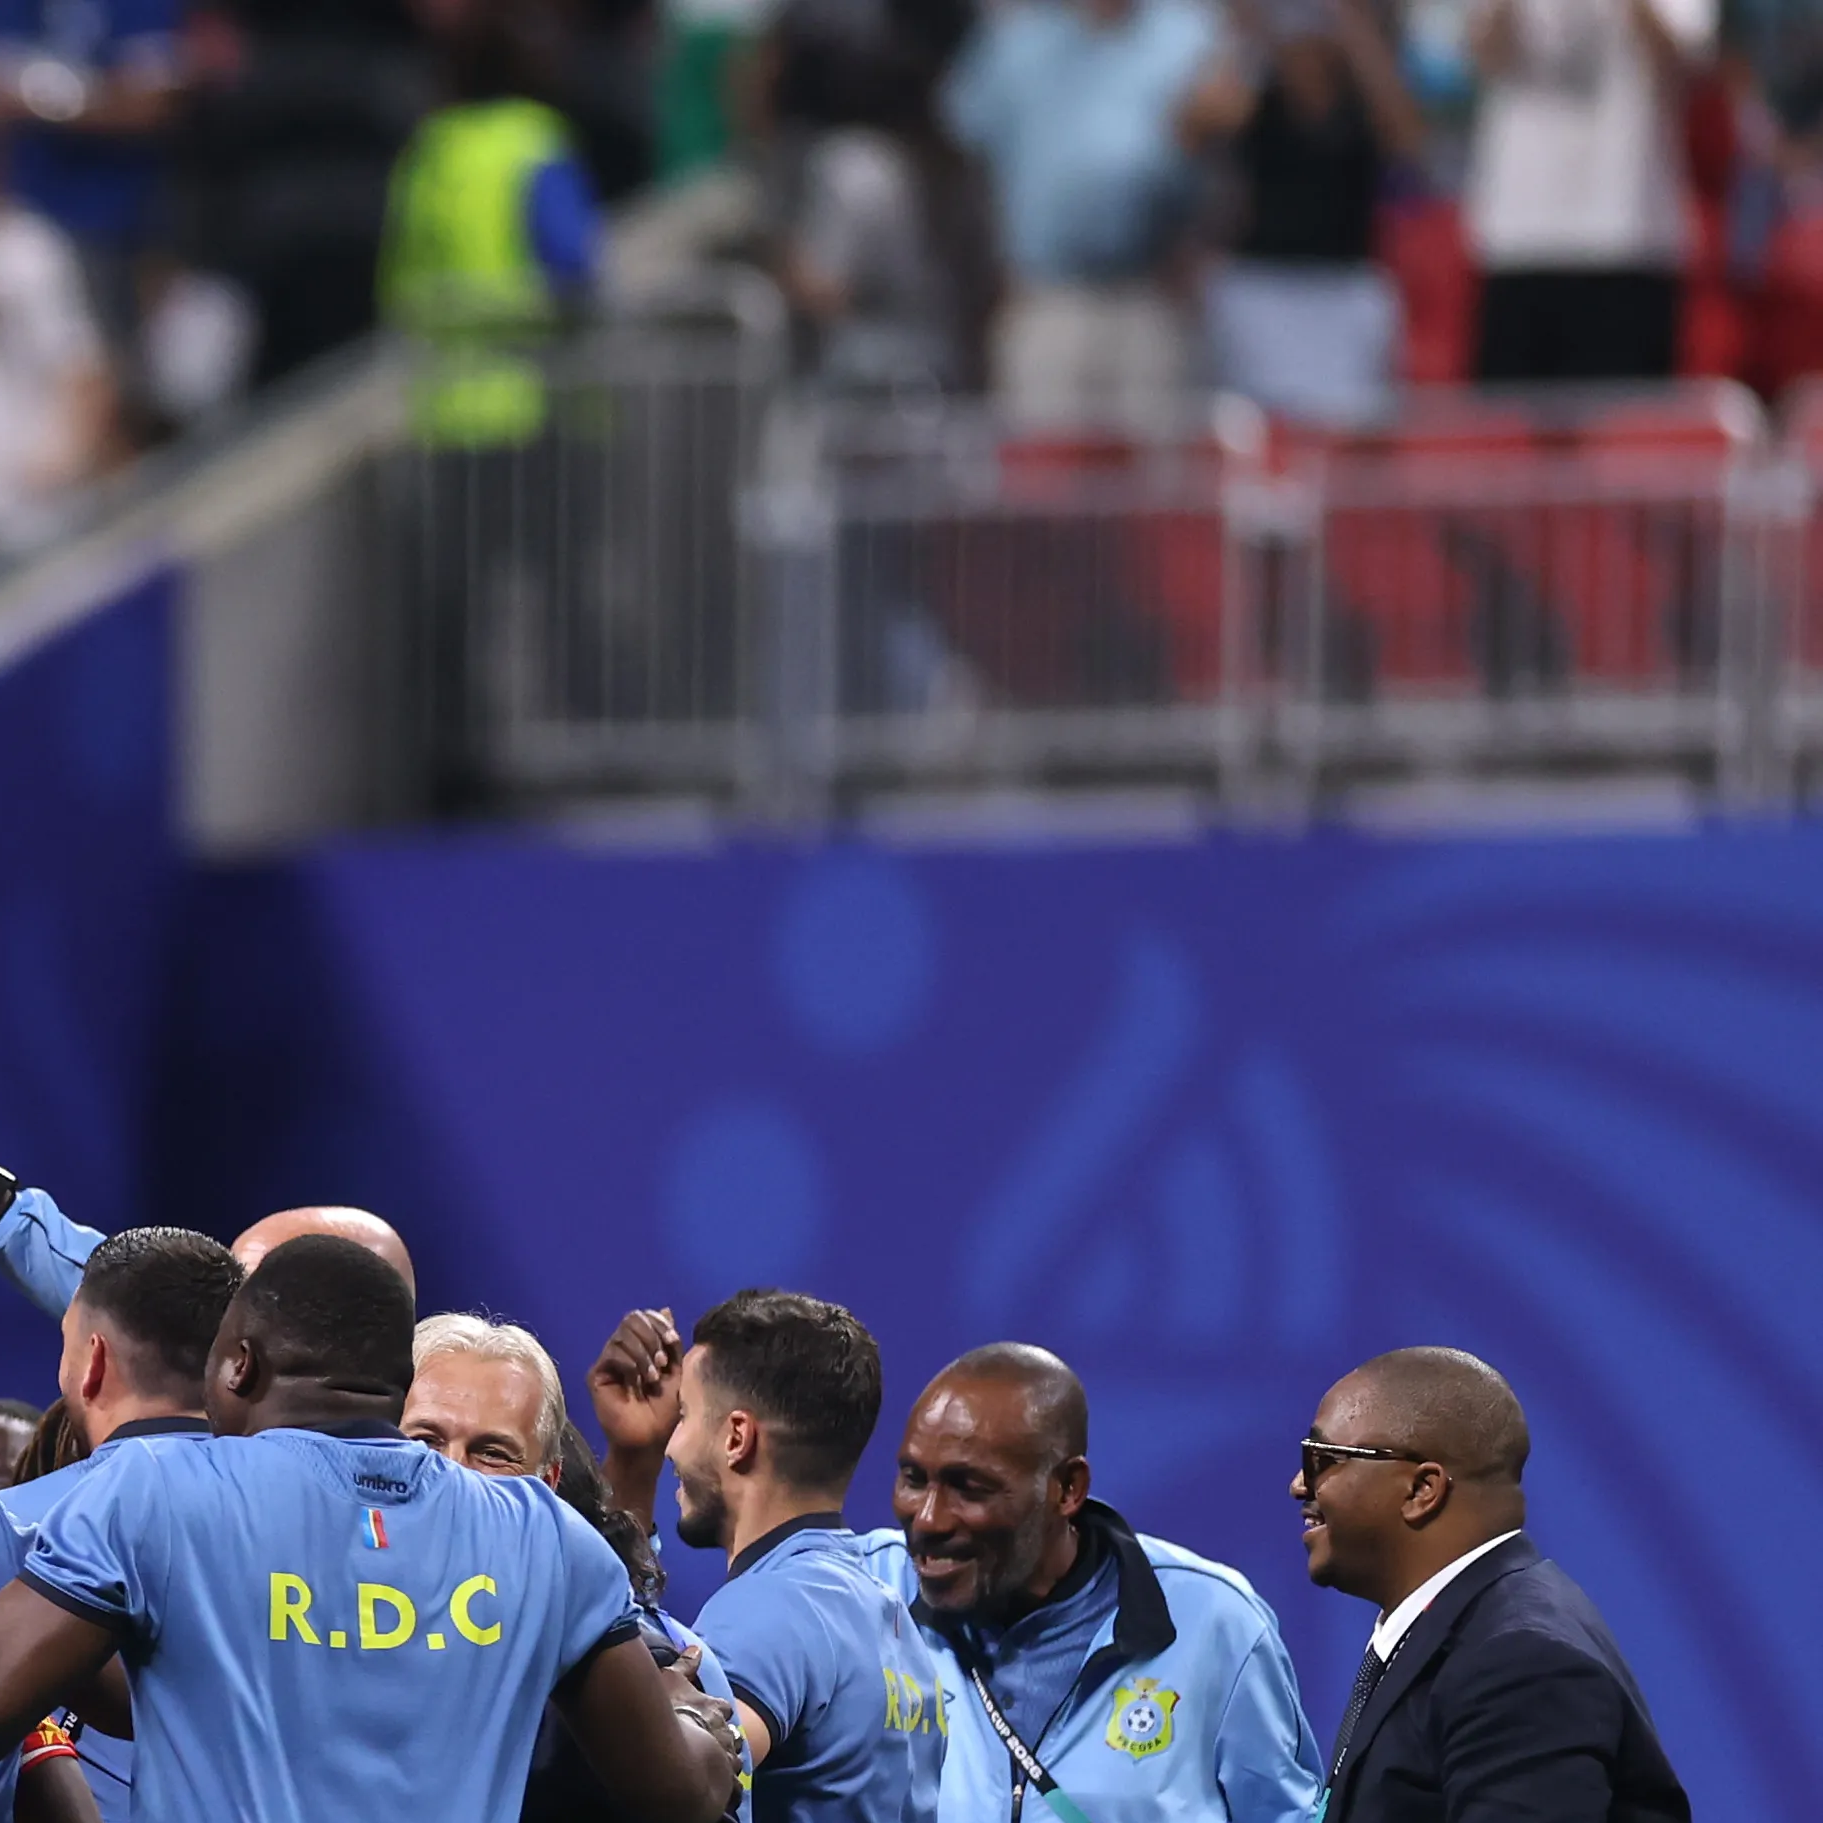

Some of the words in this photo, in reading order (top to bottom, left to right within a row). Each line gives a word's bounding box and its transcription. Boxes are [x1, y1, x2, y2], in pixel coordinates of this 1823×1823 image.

[353, 1473, 408, 1494] umbro
[269, 1572, 501, 1650] R.D.C
[991, 1710, 1011, 1737] CUP
[1006, 1735, 1043, 1782] 2026
